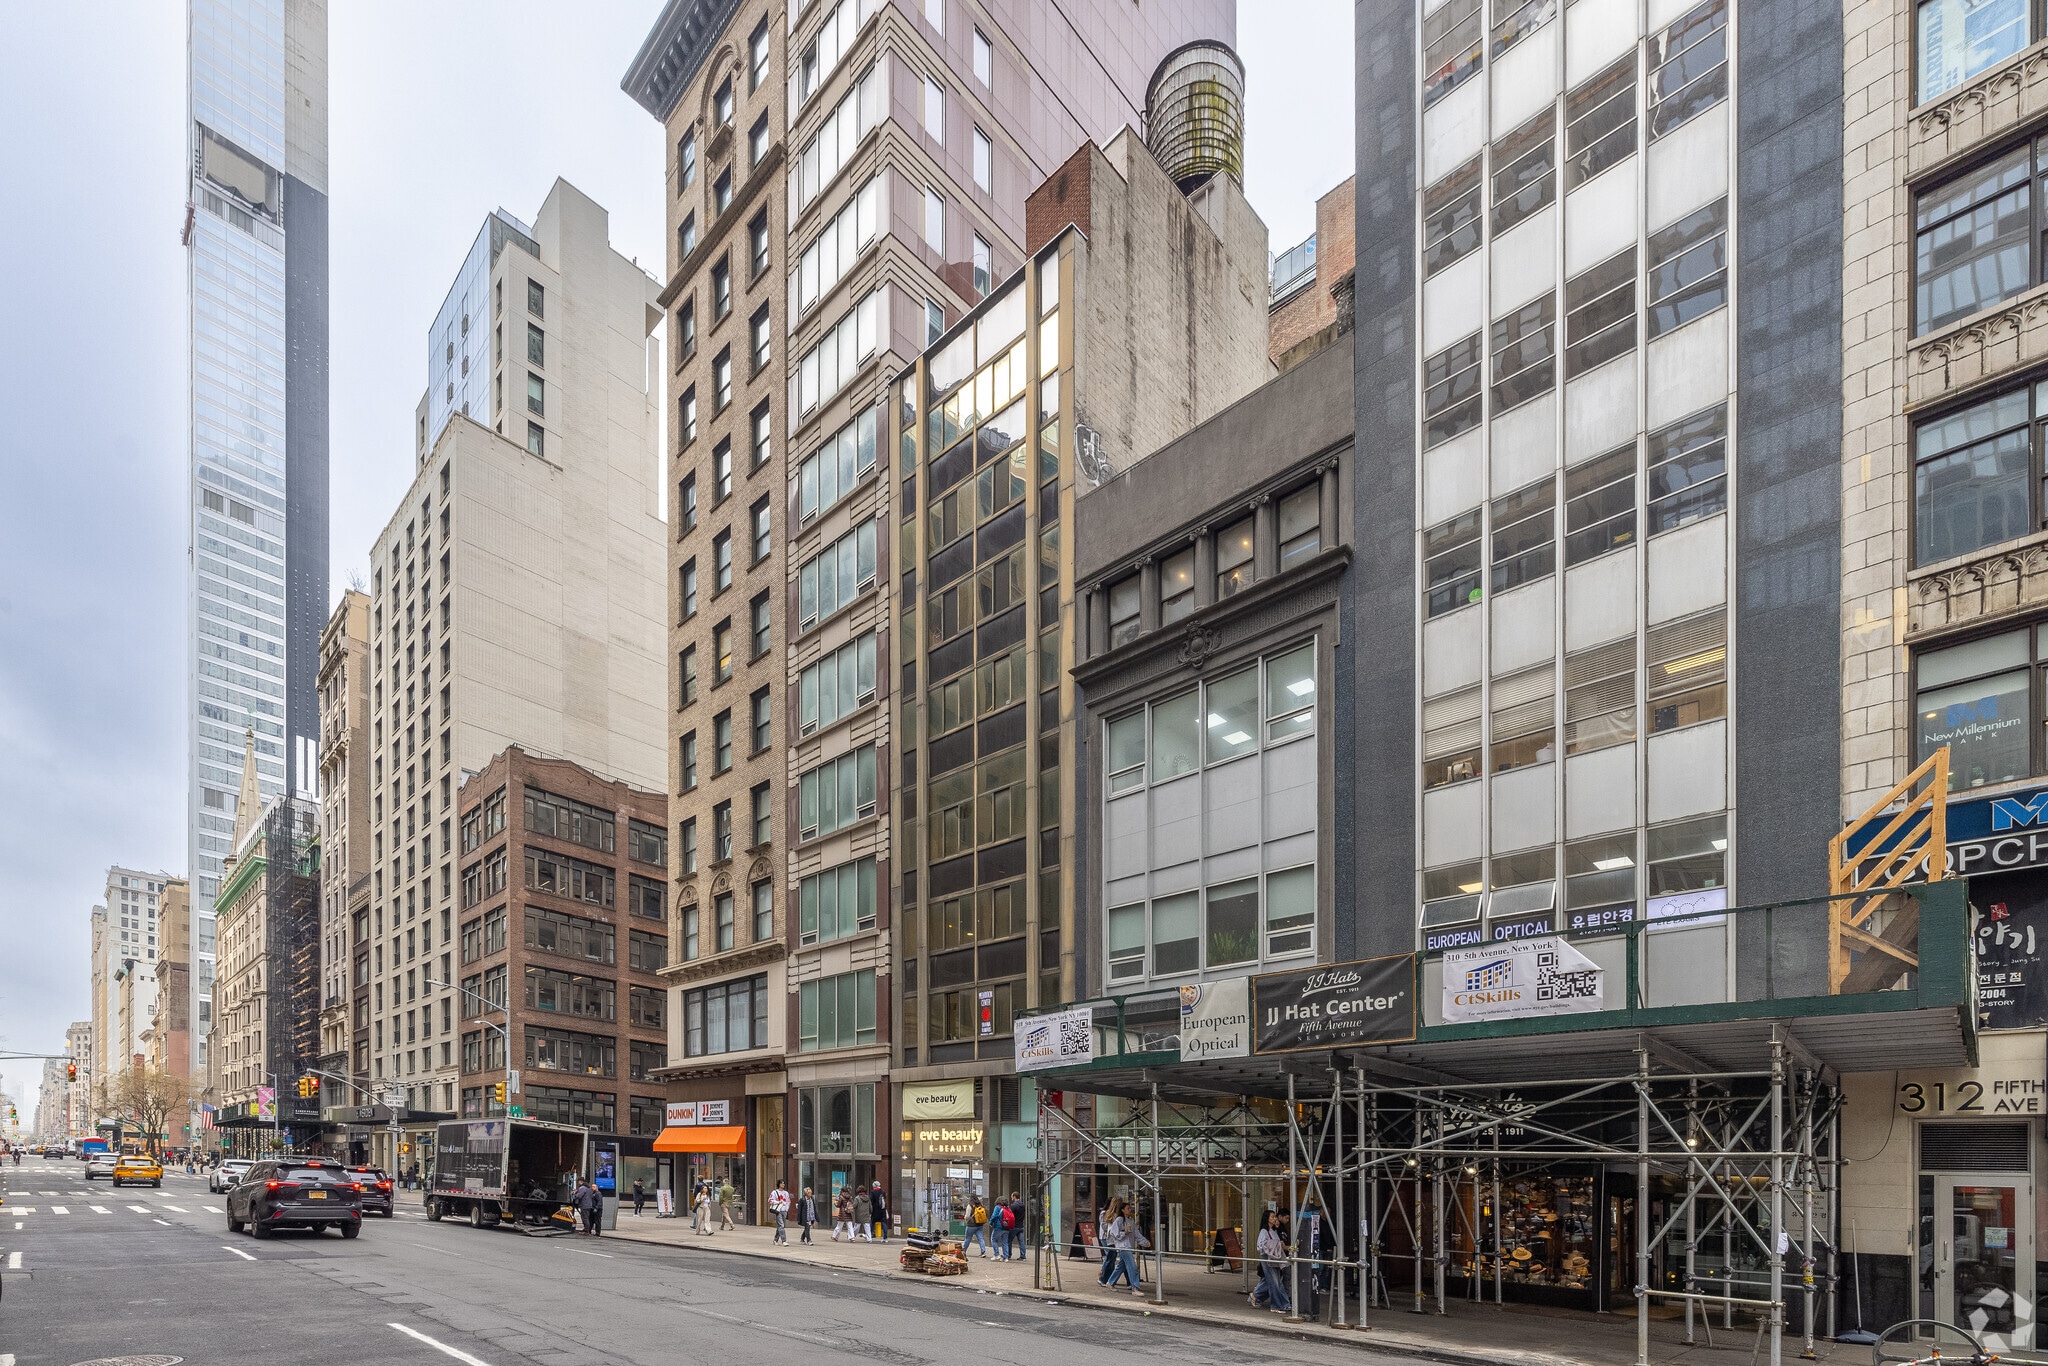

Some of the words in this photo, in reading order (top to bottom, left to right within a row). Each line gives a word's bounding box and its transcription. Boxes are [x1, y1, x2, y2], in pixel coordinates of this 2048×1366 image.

[1925, 731, 1955, 744] New
[1956, 718, 2021, 738] Millennium
[1946, 731, 1998, 747] BANK
[1571, 908, 1633, 929] 유럽안경
[1427, 929, 1481, 950] EUROPEAN
[1494, 920, 1553, 940] OPTICAL
[1446, 953, 1460, 962] 310
[1464, 951, 1477, 960] 5th
[1479, 949, 1510, 958] Avenue,
[1511, 945, 1530, 954] New
[1532, 942, 1553, 951] York
[1324, 970, 1361, 988] Hats
[1980, 972, 2021, 985] 전문점
[1454, 989, 1521, 1006] CtSkills
[1980, 989, 2006, 999] 2004
[1265, 1007, 1279, 1027] JJ
[1285, 1002, 1320, 1021] Hat
[1183, 1014, 1246, 1032] European
[1299, 1019, 1322, 1035] Fifth
[1325, 1019, 1363, 1031] Avenue
[1297, 1034, 1320, 1042] NEW
[1332, 1030, 1365, 1039] YORK
[1189, 1033, 1239, 1056] Optical
[1021, 1047, 1054, 1059] CtSkills
[1993, 1079, 2045, 1094] FIFTH
[916, 1096, 929, 1104] eve
[930, 1094, 957, 1104] beauty
[1900, 1082, 1985, 1113] 312
[1994, 1098, 2038, 1113] AVE
[830, 1131, 841, 1140] 304
[919, 1130, 940, 1141] eve
[941, 1128, 983, 1144] beauty
[1505, 1127, 1524, 1135] 1911
[929, 1144, 974, 1153] K-BEAUTY
